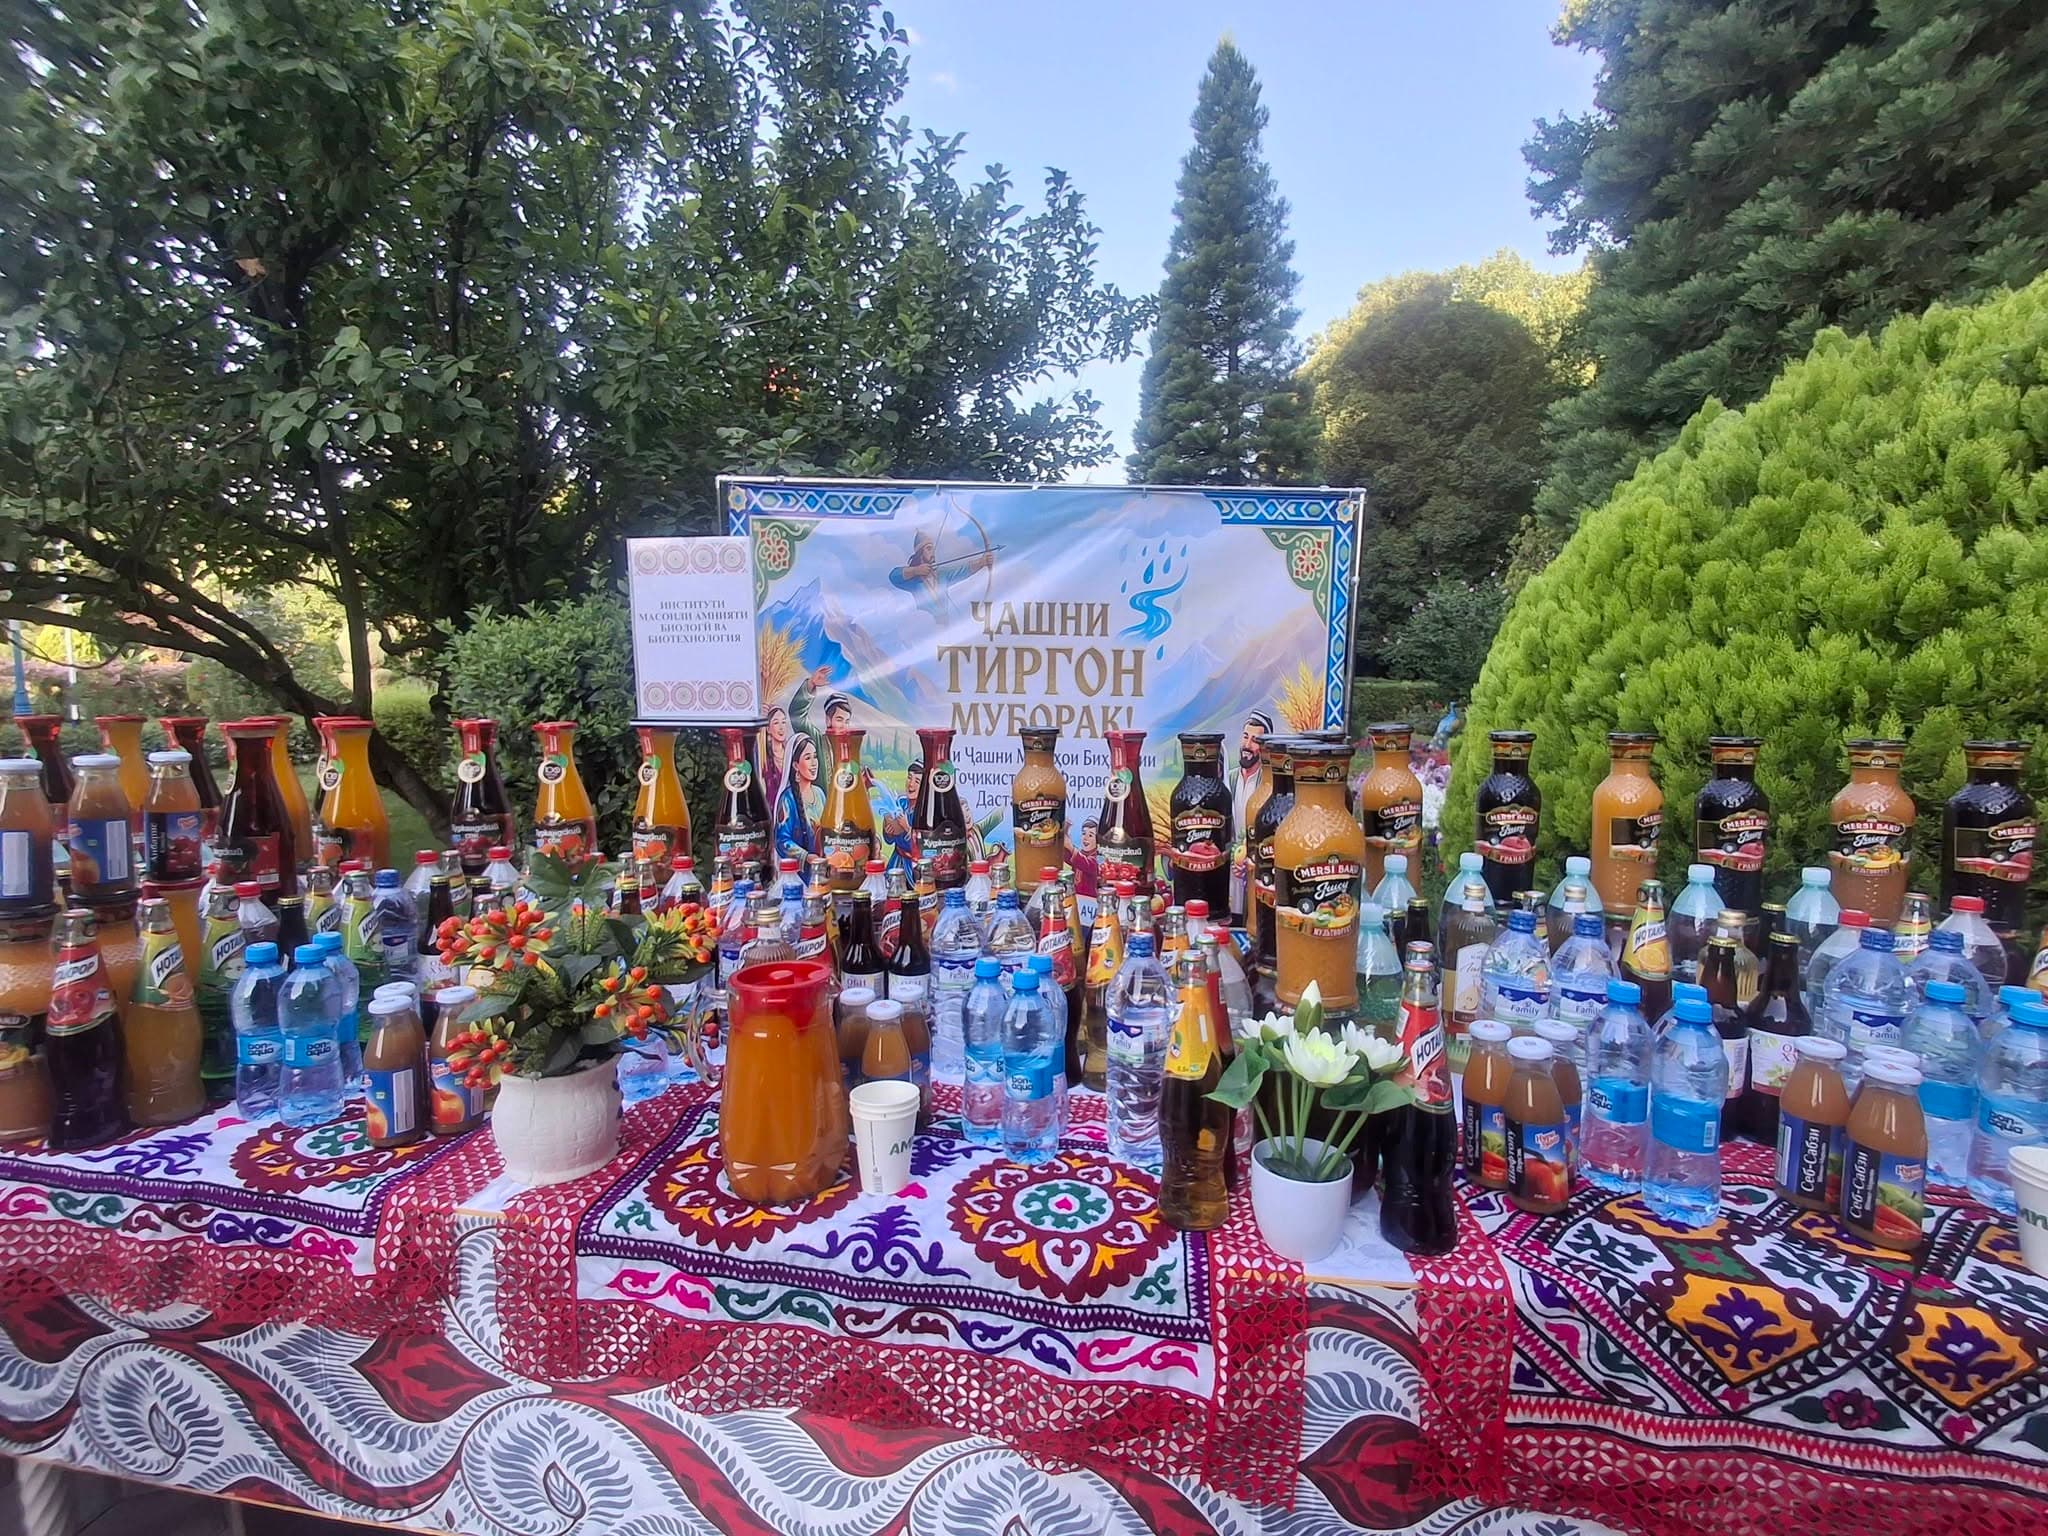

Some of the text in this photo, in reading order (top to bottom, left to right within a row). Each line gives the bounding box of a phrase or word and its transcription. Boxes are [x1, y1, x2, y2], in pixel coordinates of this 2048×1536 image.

[659, 600, 725, 609] ИНСТИТУТИ
[639, 611, 749, 621] МАСОИЛИ АМНИЯТИ
[970, 602, 1110, 641] ҶАШНИ
[714, 624, 727, 632] ВА
[648, 633, 742, 644] БИОТЕХНОЛОГИЯ
[937, 645, 1145, 698] ТИРГОН
[951, 702, 1136, 738] МУБОРАК!
[1842, 821, 1873, 832] MERSI
[1301, 865, 1336, 879] MERSI
[1314, 881, 1349, 900] Juicy
[1510, 1004, 1540, 1016] Family
[1800, 1127, 1821, 1193] Себ-Сабзи
[1849, 1150, 1869, 1219] Себ-Сабзи
